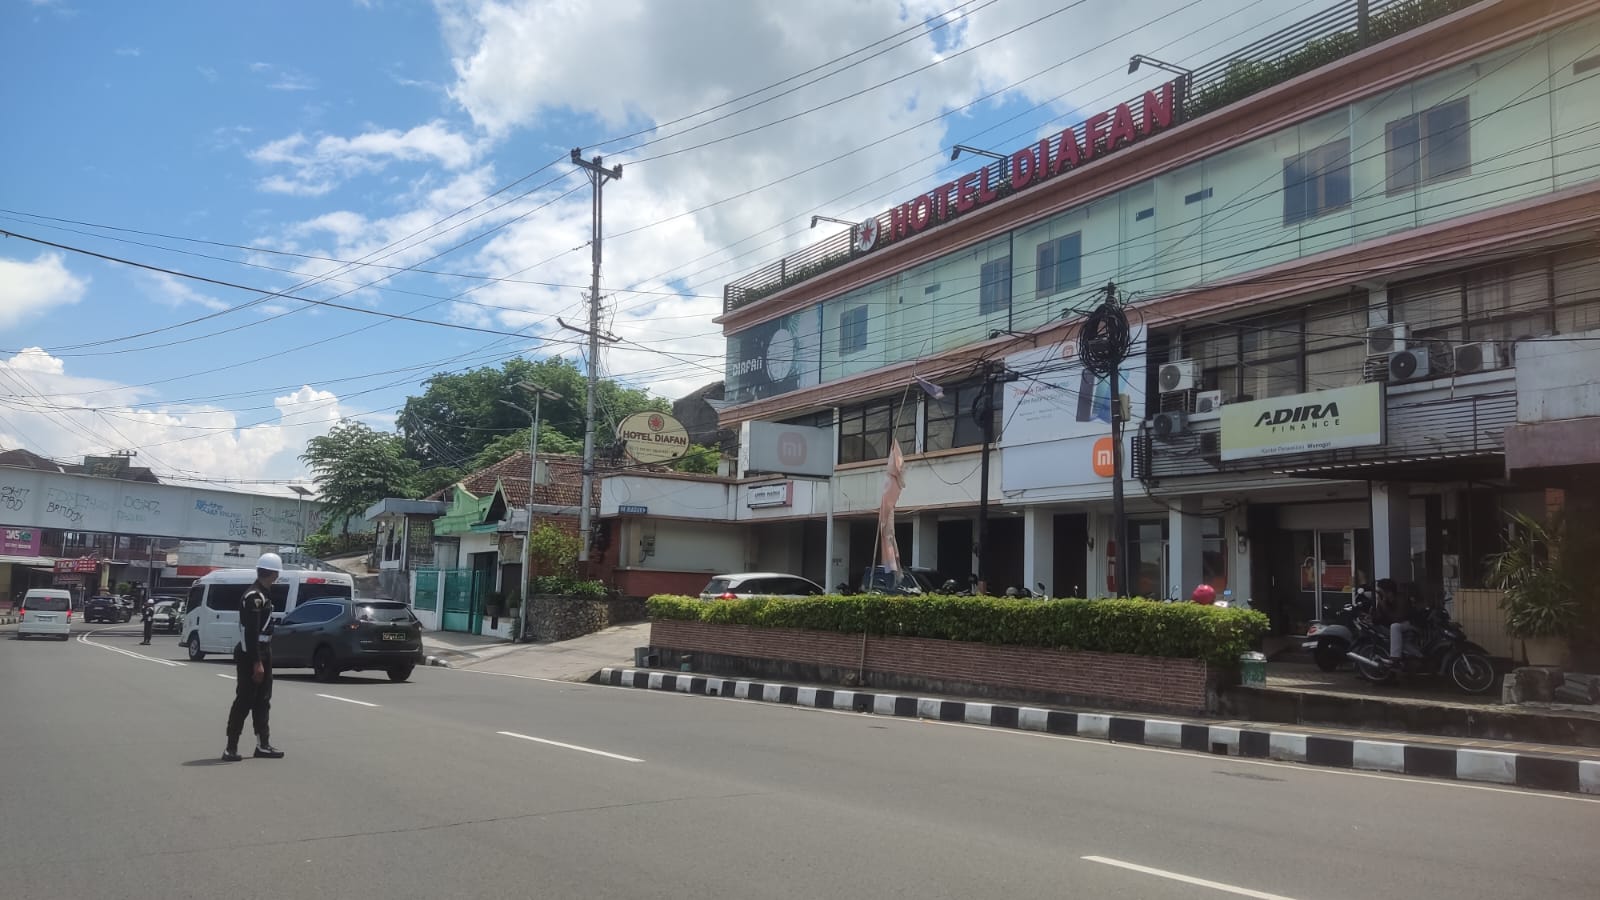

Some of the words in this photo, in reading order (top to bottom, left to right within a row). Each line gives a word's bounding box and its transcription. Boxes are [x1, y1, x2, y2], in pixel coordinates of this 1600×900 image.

[890, 165, 997, 240] HOTEL
[1012, 82, 1173, 189] DIAFAN
[1254, 402, 1339, 427] ADIRA
[1271, 418, 1341, 433] FINANCE
[623, 430, 653, 442] HOTEL
[654, 434, 687, 446] DIAFAN
